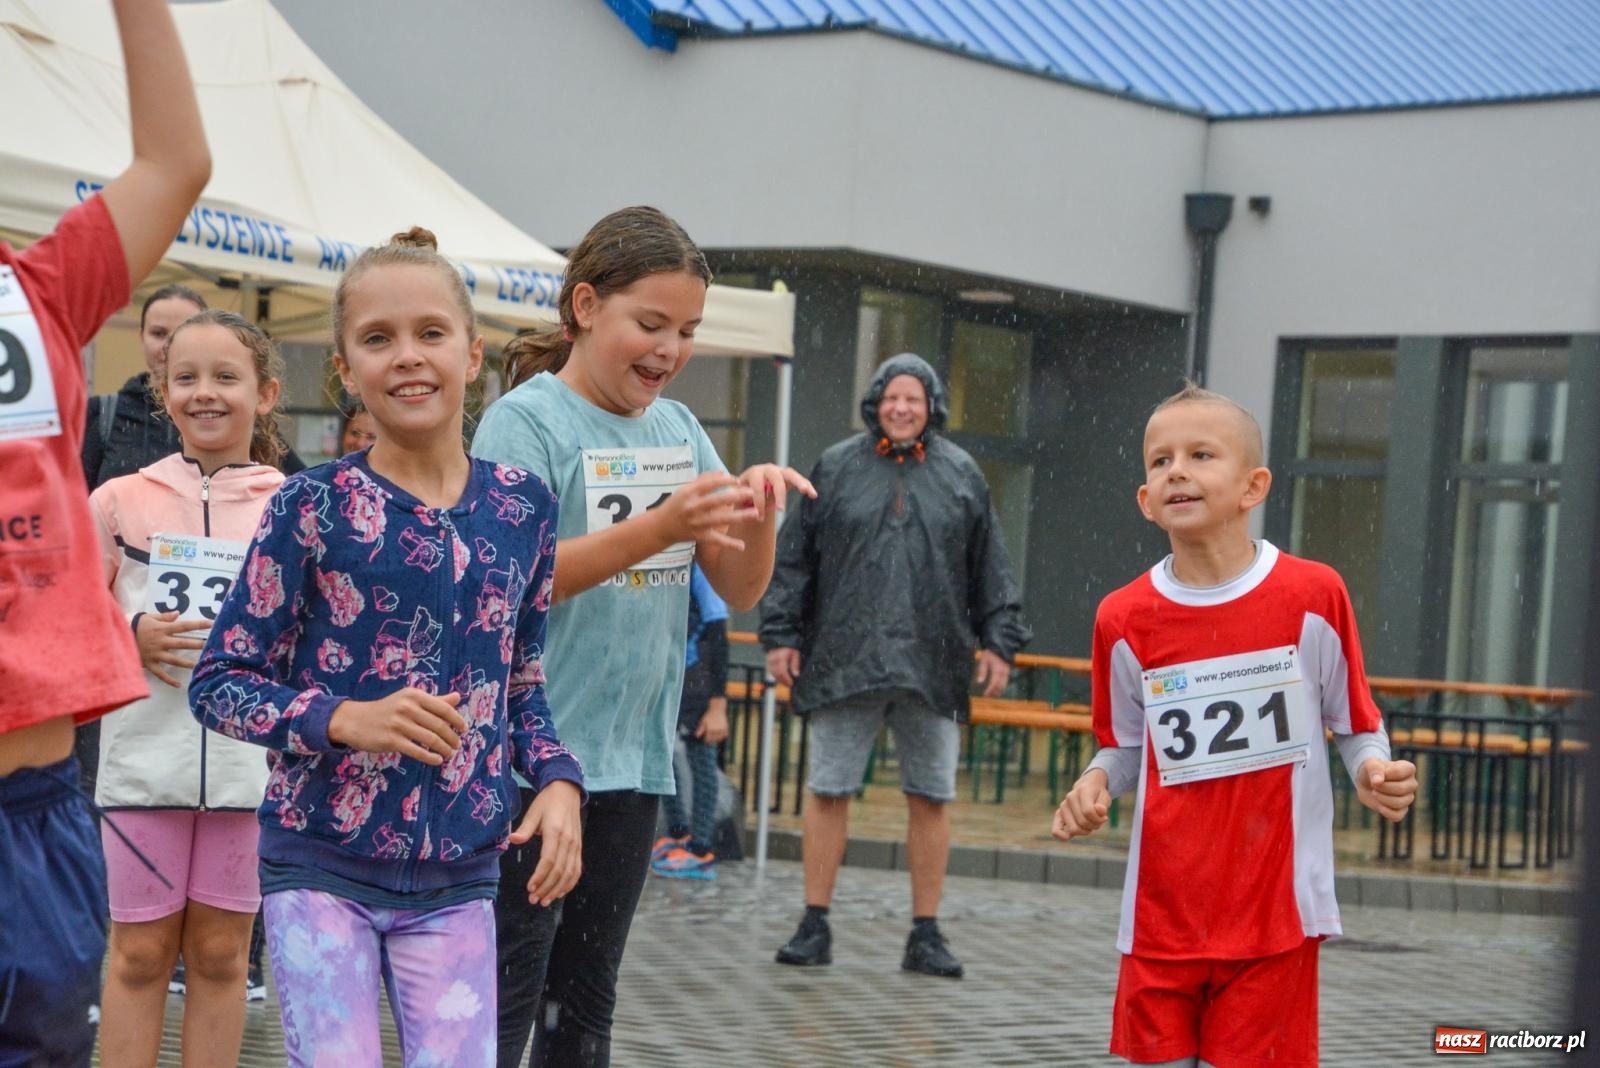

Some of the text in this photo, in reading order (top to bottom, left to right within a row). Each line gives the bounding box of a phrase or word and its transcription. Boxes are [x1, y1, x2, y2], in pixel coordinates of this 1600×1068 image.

[0, 326, 33, 404] 9
[1195, 659, 1293, 682] www.personalbest.pl
[1158, 691, 1290, 761] 321
